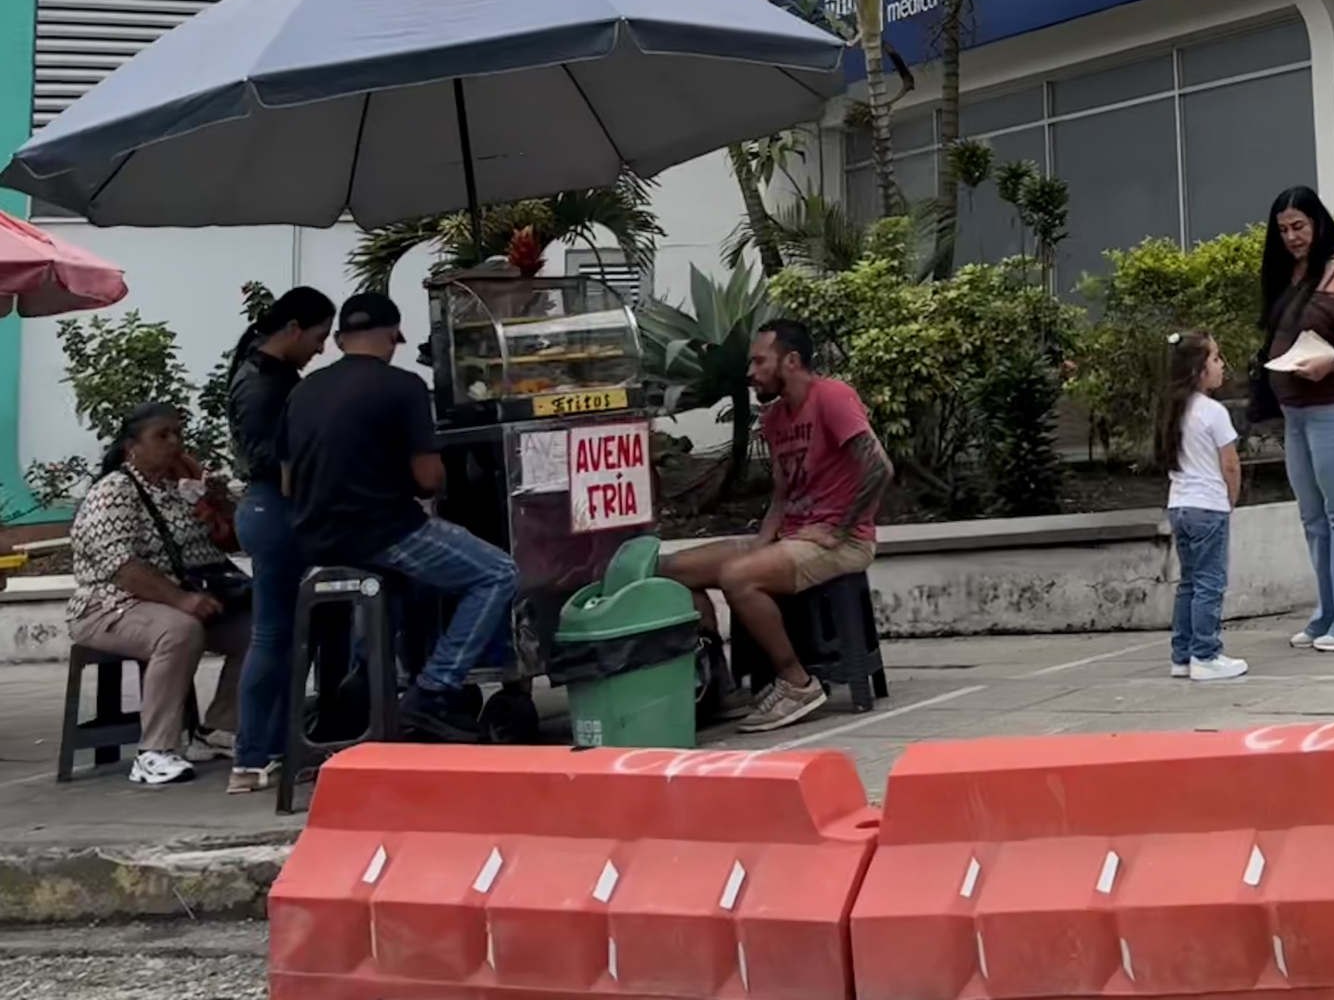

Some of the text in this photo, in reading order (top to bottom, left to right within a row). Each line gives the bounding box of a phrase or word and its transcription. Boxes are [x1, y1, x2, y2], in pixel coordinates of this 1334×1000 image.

[551, 394, 611, 414] Fritos
[576, 432, 644, 474] AVENA
[586, 472, 638, 520] FRÍA
